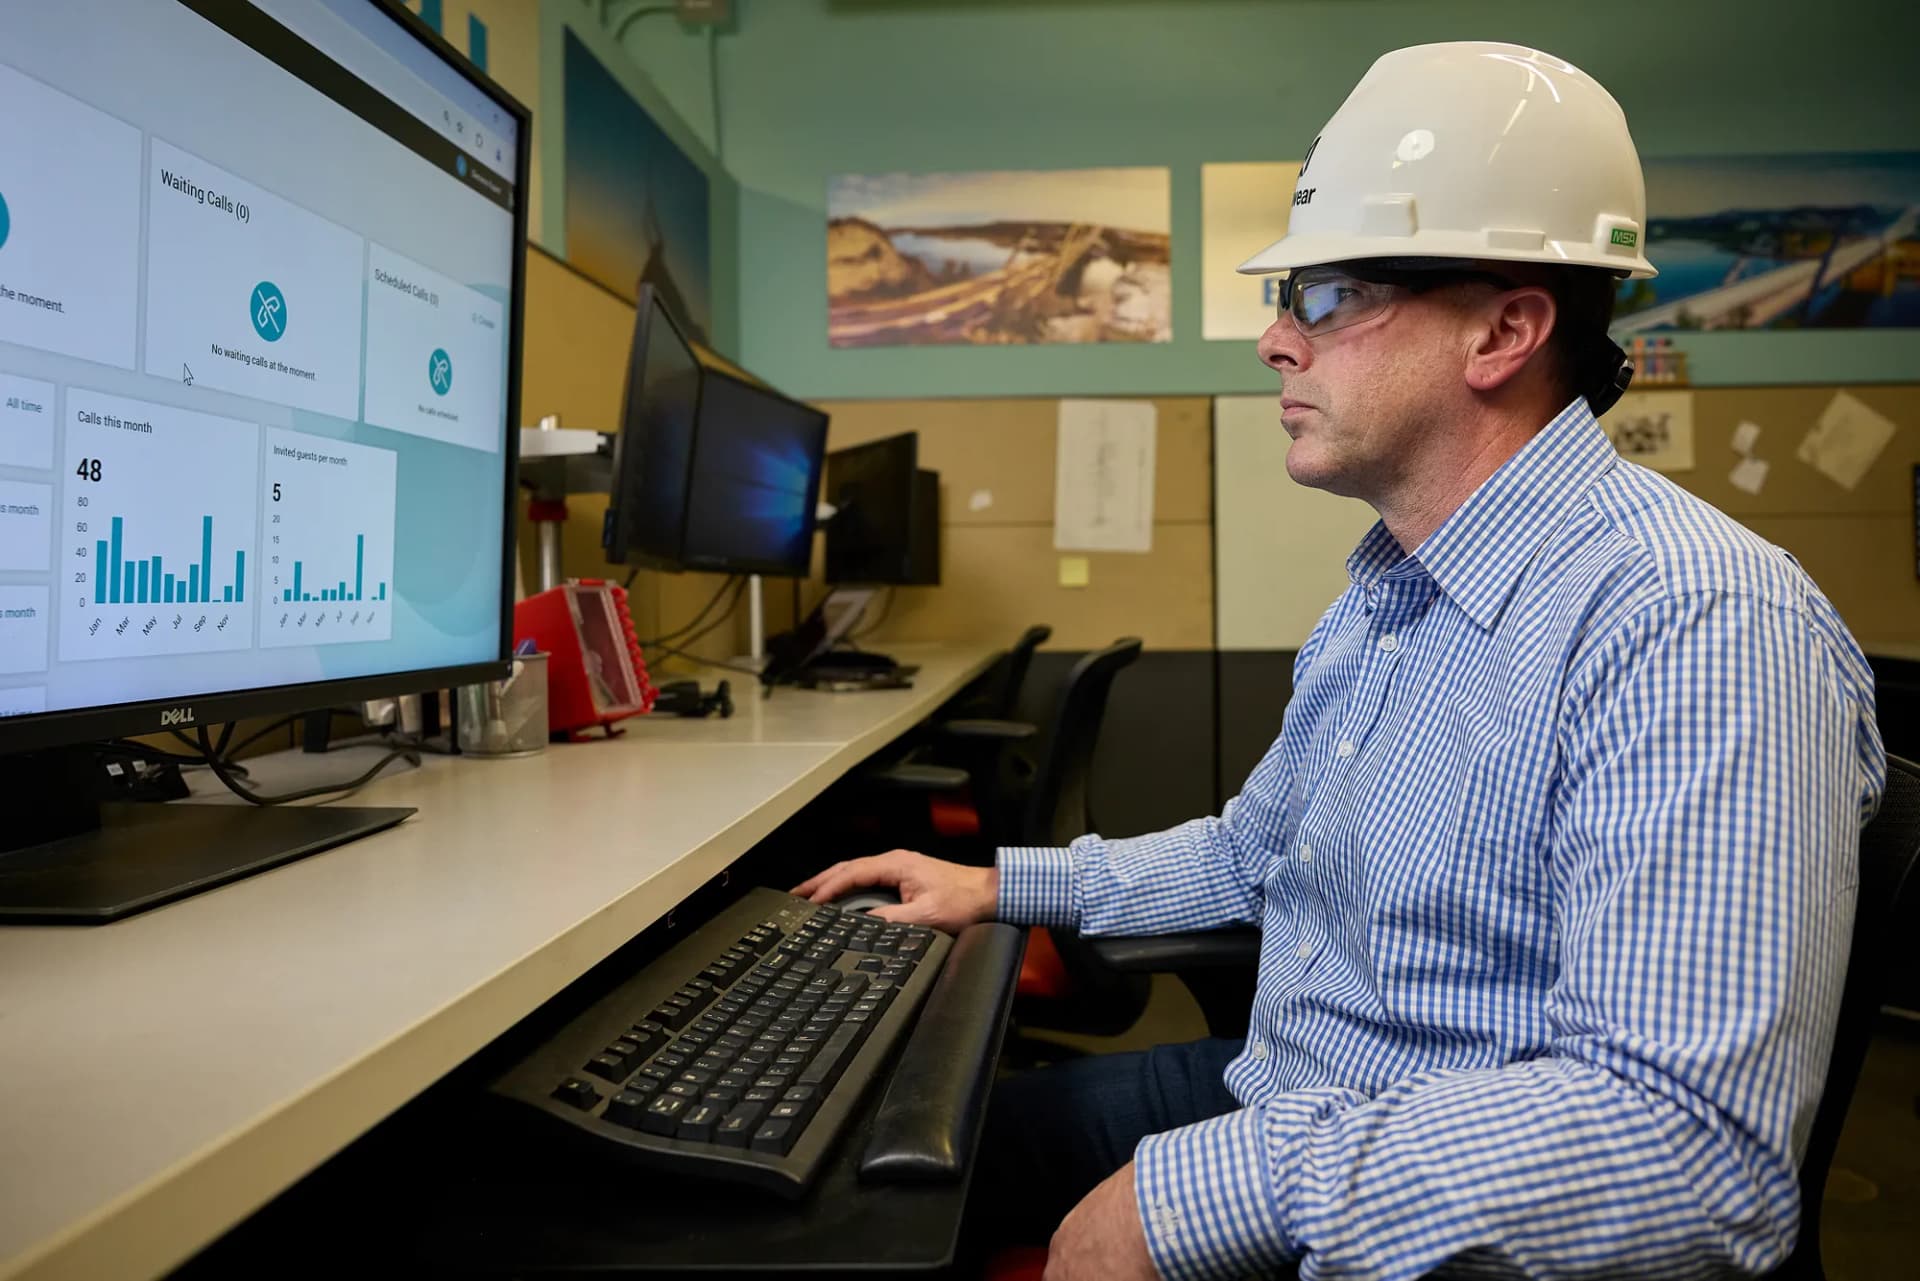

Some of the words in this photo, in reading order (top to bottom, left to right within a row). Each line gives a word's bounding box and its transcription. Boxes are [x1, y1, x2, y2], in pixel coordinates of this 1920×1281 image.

[161, 168, 204, 204] Waiting
[207, 190, 233, 213] Calls
[236, 202, 250, 224] (0)
[1613, 230, 1636, 245] MSA
[17, 292, 65, 313] moment.
[211, 343, 223, 355] No
[224, 349, 251, 366] waiting
[251, 355, 268, 368] calls
[269, 361, 277, 371] at
[277, 362, 289, 374] the
[21, 400, 42, 413] time
[78, 410, 102, 425] Calls
[103, 414, 122, 429] this
[123, 420, 153, 434] month
[273, 445, 296, 458] Invited
[296, 451, 318, 461] guests
[76, 458, 102, 482] 48
[272, 483, 281, 502] 5
[77, 496, 89, 507] 80
[8, 504, 40, 516] month
[272, 514, 281, 524] 20
[76, 521, 88, 533] 60
[272, 535, 280, 545] 15
[75, 547, 87, 558] 40
[272, 555, 280, 565] 10
[74, 572, 87, 583] 20
[273, 575, 279, 585] 5
[78, 597, 86, 608] 0
[89, 617, 103, 637] Jan
[114, 616, 131, 637] Mar
[141, 616, 158, 637] May
[171, 614, 183, 630] Jul
[193, 615, 207, 633] Sep
[215, 614, 230, 632] Nov
[160, 707, 195, 726] DELL
